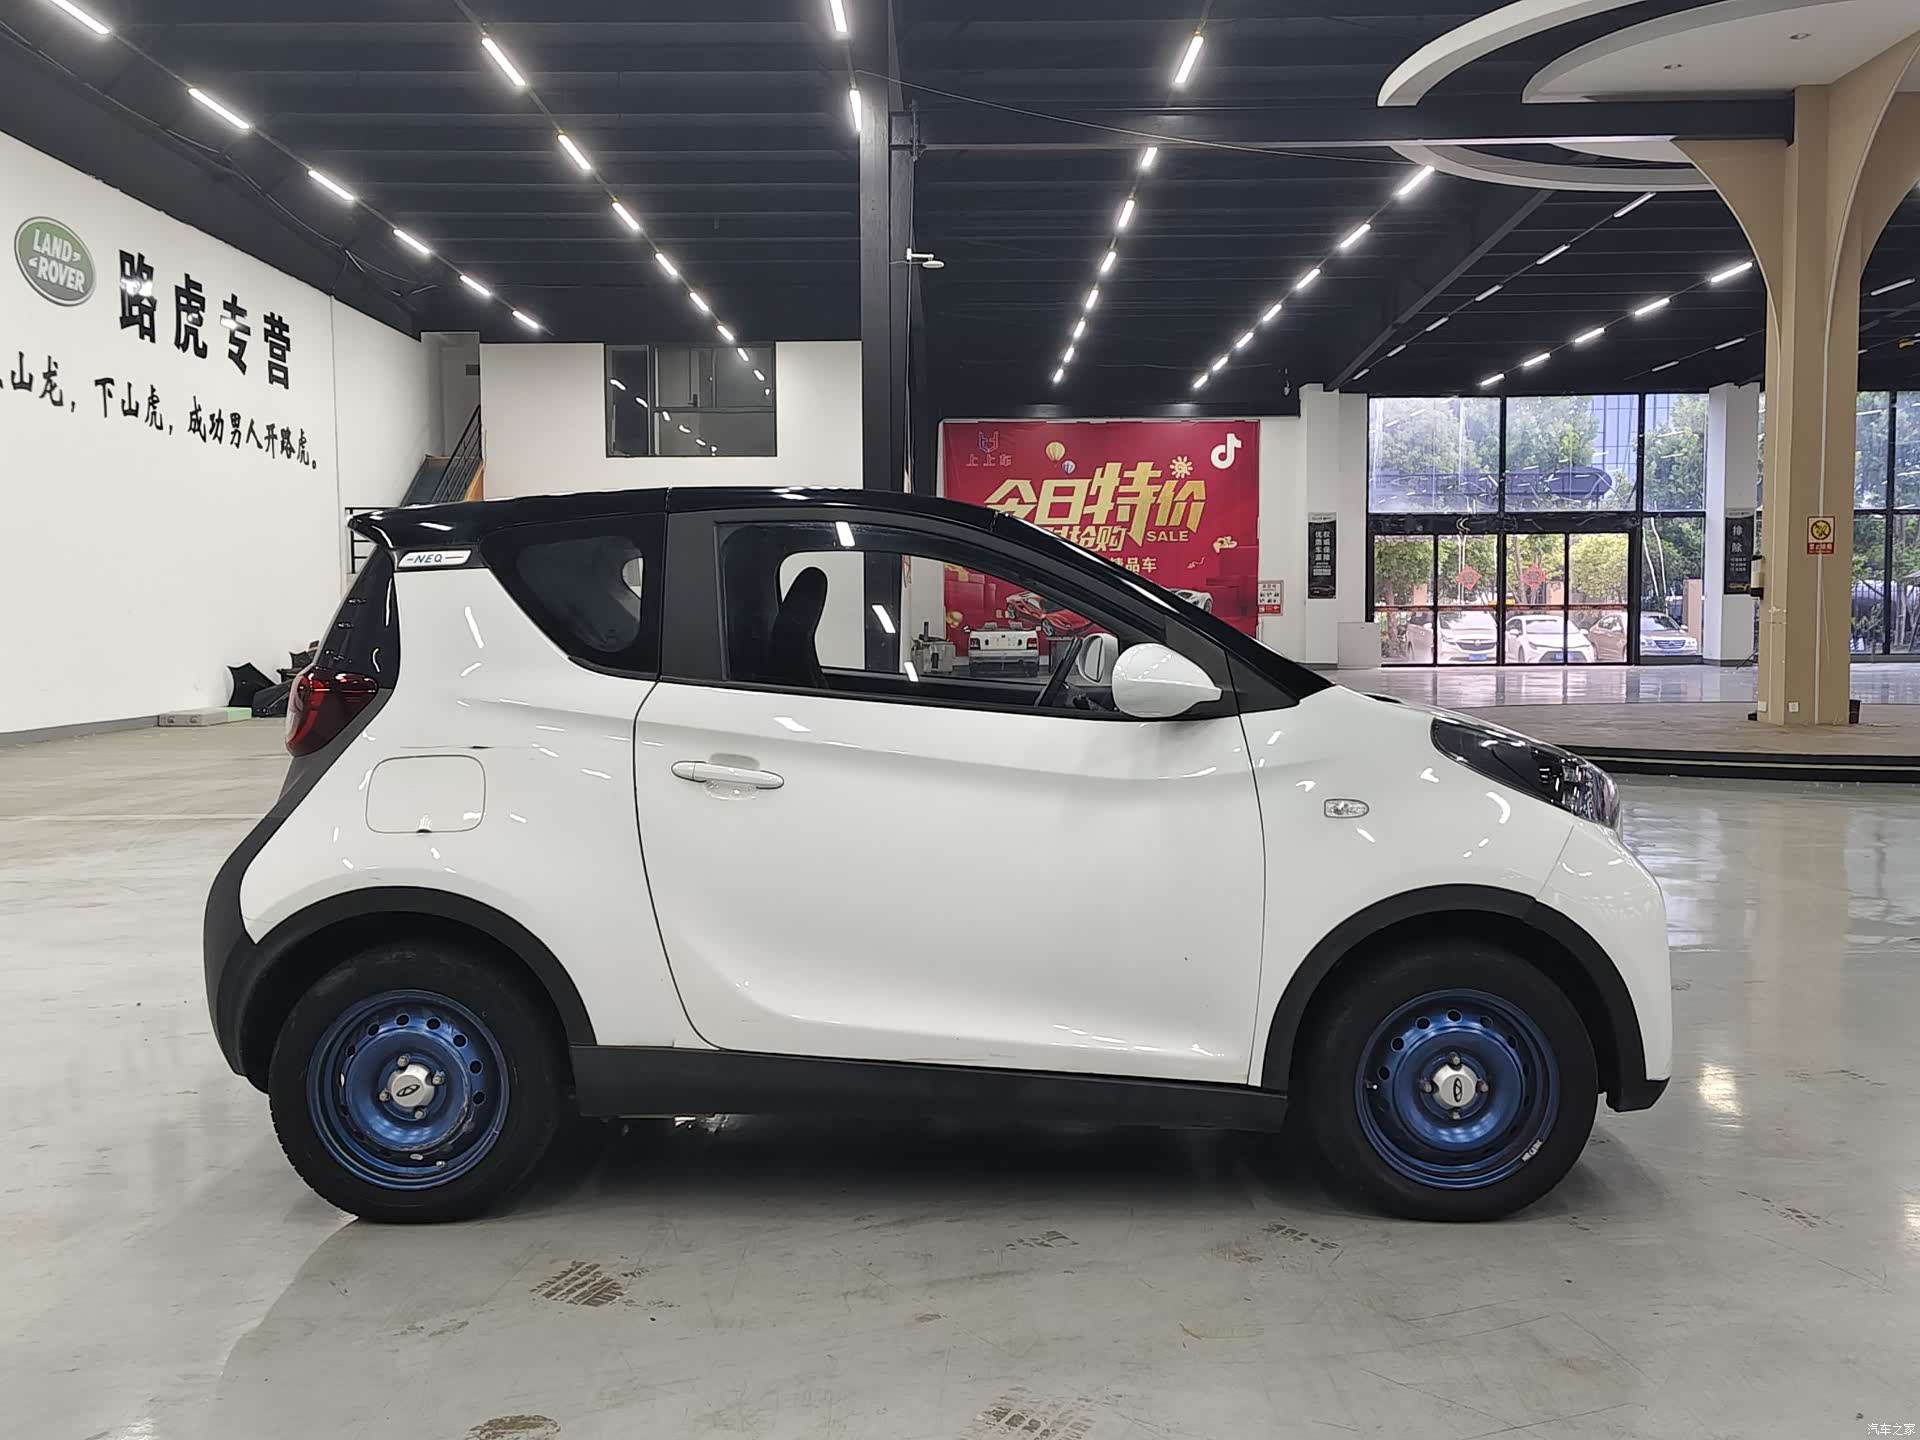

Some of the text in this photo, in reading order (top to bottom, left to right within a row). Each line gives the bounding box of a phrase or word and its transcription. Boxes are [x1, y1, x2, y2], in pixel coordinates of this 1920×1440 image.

[33, 229, 74, 262] LAND
[37, 258, 86, 294] ROVER
[119, 249, 292, 390] 路虎专营
[984, 462, 1207, 547] 今日特价
[1147, 531, 1189, 542] SALE
